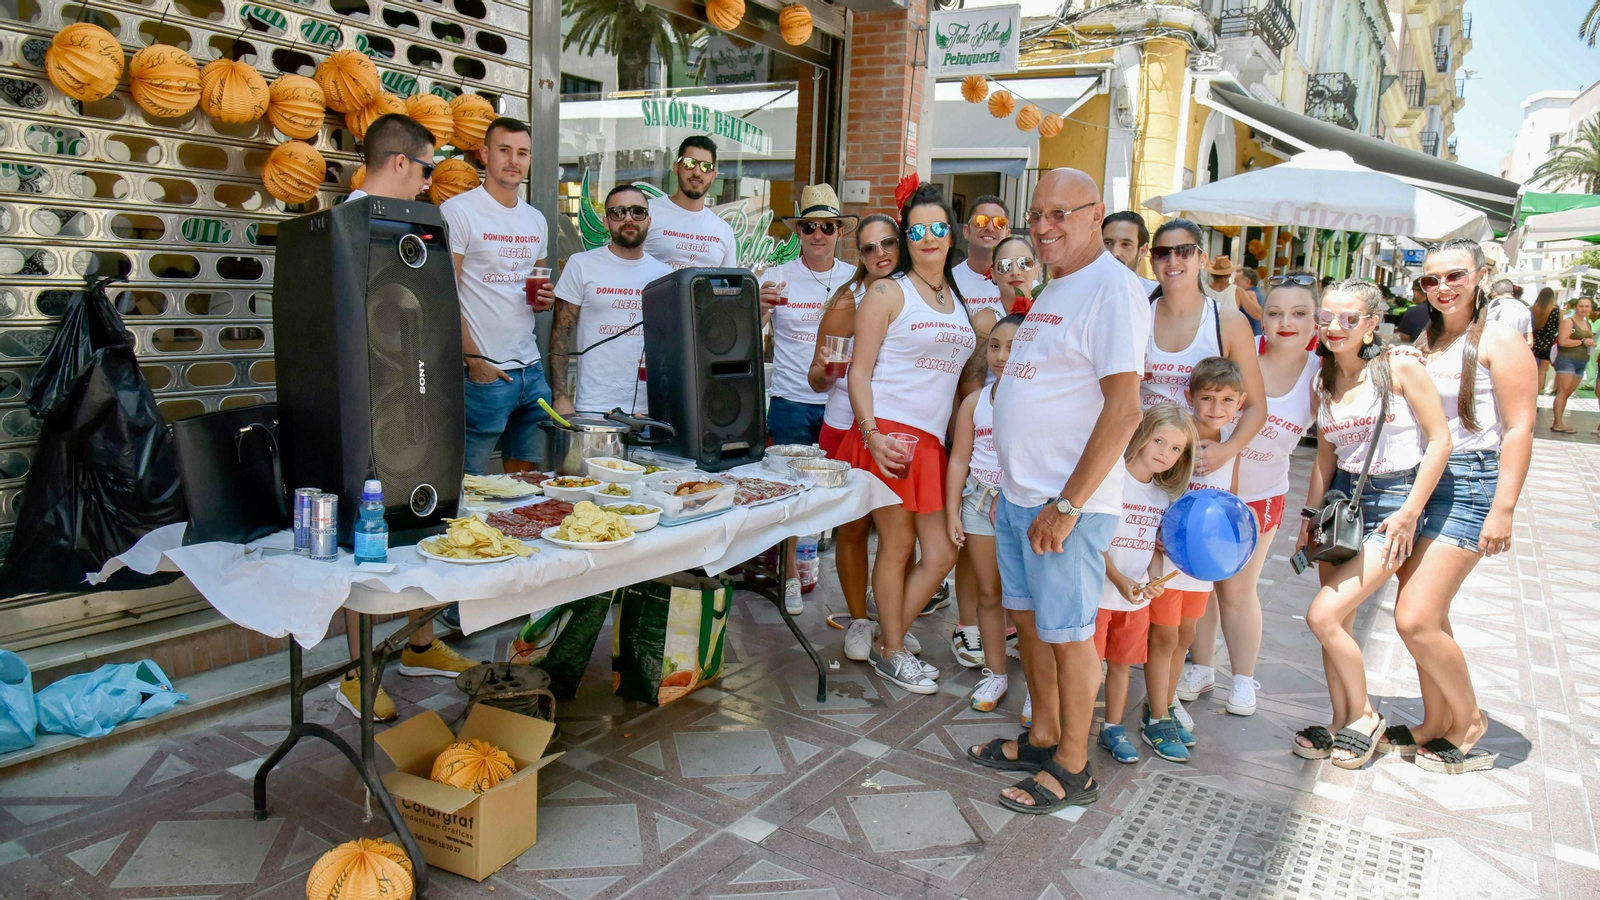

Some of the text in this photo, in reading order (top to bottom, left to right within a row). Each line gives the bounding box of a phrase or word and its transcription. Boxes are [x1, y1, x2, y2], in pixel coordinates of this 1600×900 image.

[970, 20, 1000, 51] Bella
[942, 50, 1000, 66] Peluquería
[641, 96, 764, 152] SALÓN DE BELLEZA
[483, 232, 540, 243] DOMINGO ROCIERO
[662, 229, 720, 243] DOMINGO ROCIERO
[499, 245, 532, 259] ALEGRÍA
[676, 241, 710, 253] ALEGRÍA
[596, 287, 634, 296] DOMINGO
[612, 299, 643, 310] ALEGR
[911, 322, 957, 331] DOMINGO
[418, 359, 426, 394] SONY
[1267, 413, 1304, 435] OCIERO
[1353, 413, 1396, 427] ROCIRO
[1148, 506, 1166, 516] ROCIE
[1111, 537, 1148, 550] SANGRÍA
[402, 799, 474, 829] Colorgraf
[401, 812, 474, 840] Industrias Gráficas
[428, 838, 438, 846] 956
